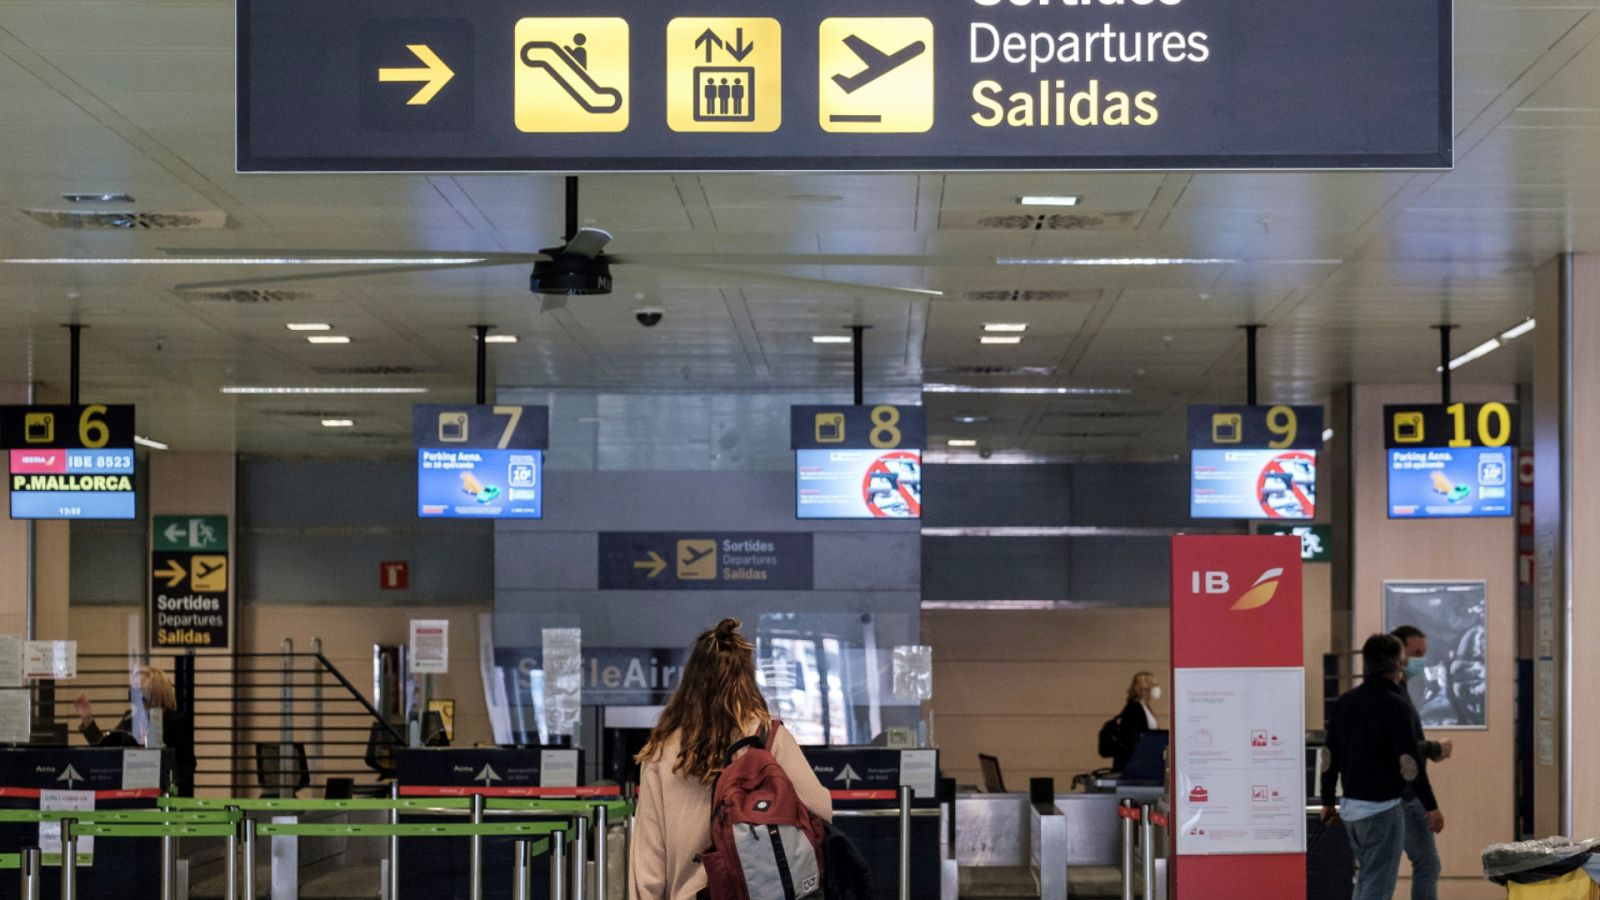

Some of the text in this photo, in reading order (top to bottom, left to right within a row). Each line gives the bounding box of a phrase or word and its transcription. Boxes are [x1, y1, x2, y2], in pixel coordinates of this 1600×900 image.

[969, 22, 1210, 73] Departures
[970, 79, 1160, 127] Salidas
[78, 404, 110, 449] 6
[492, 405, 524, 449] 7
[868, 404, 902, 449] 8
[1265, 405, 1298, 449] 9
[1446, 401, 1511, 448] 10
[68, 455, 131, 468] IBE 8523
[423, 451, 457, 462] Parking
[13, 475, 132, 491] P.MALLORCA
[722, 539, 775, 552] Sortides
[722, 553, 778, 567] Departures
[722, 567, 768, 580] Salidas
[1191, 570, 1231, 594] IB
[157, 595, 220, 611] Sortides
[157, 612, 223, 628] Departures
[157, 629, 211, 645] Salidas
